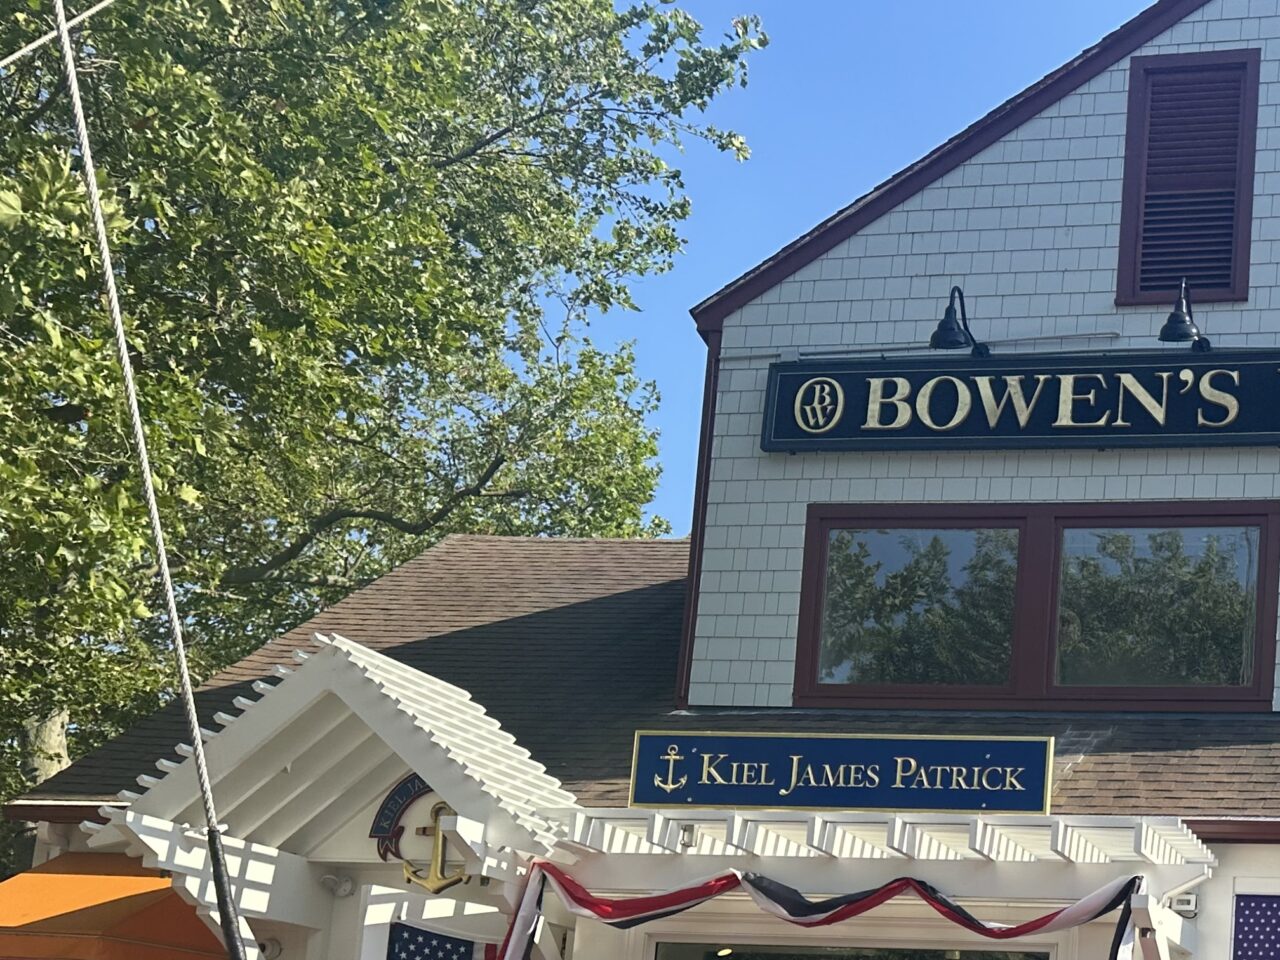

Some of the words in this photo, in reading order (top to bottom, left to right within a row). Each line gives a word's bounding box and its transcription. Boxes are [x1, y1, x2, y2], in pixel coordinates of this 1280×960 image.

[860, 368, 1240, 431] BOWEN'S
[698, 753, 775, 786] KIEL
[779, 755, 881, 796] JAMES
[892, 756, 1026, 792] PATRICK
[380, 797, 407, 828] KIEL
